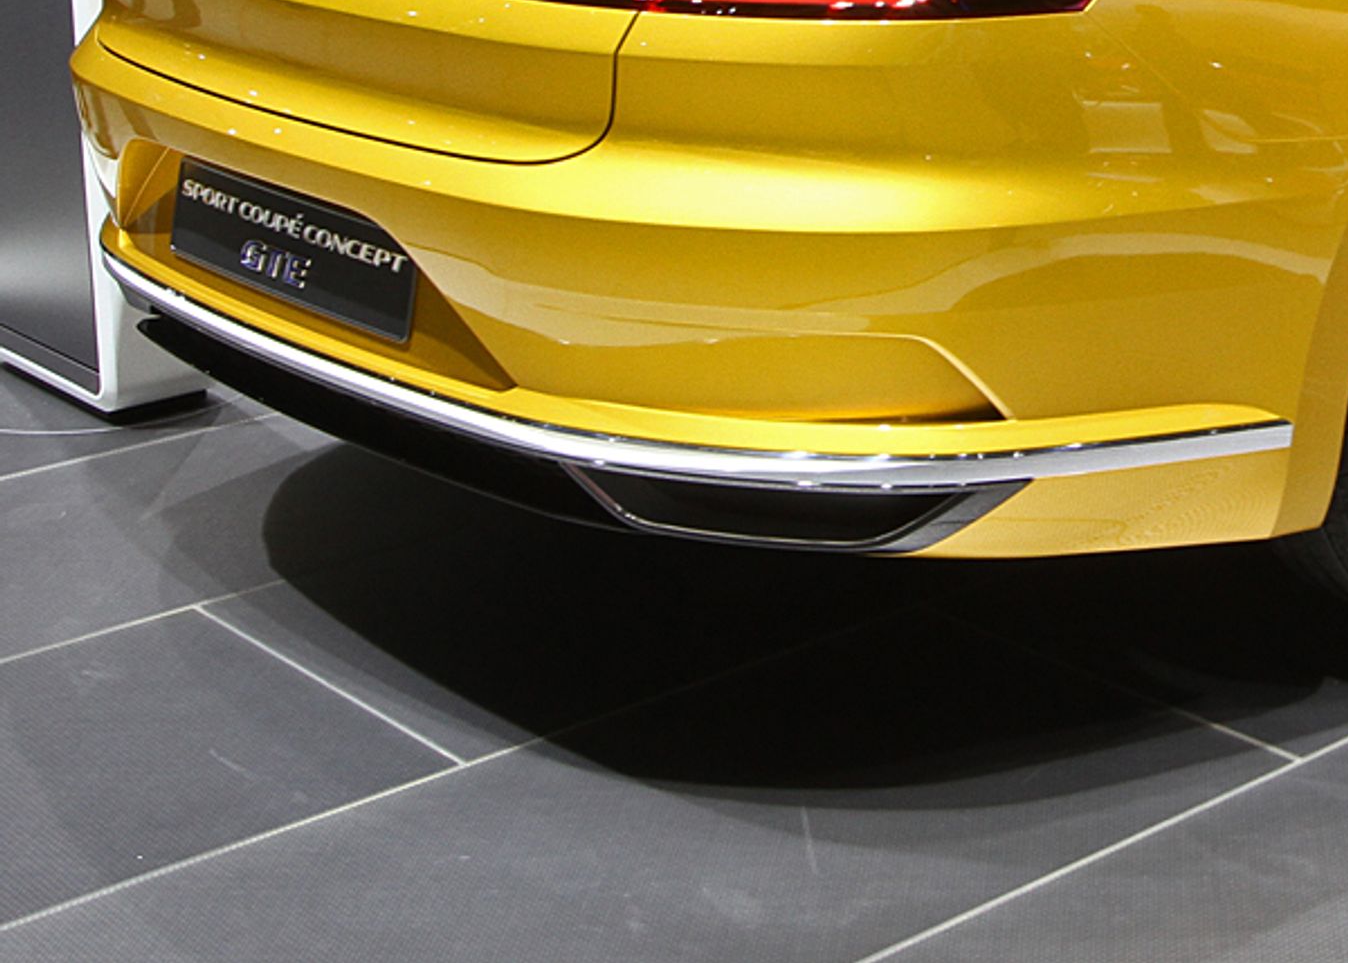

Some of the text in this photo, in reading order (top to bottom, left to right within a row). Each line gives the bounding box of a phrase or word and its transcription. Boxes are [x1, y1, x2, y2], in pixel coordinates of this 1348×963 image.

[181, 178, 408, 274] SPORT COUPÉ CONCEPT
